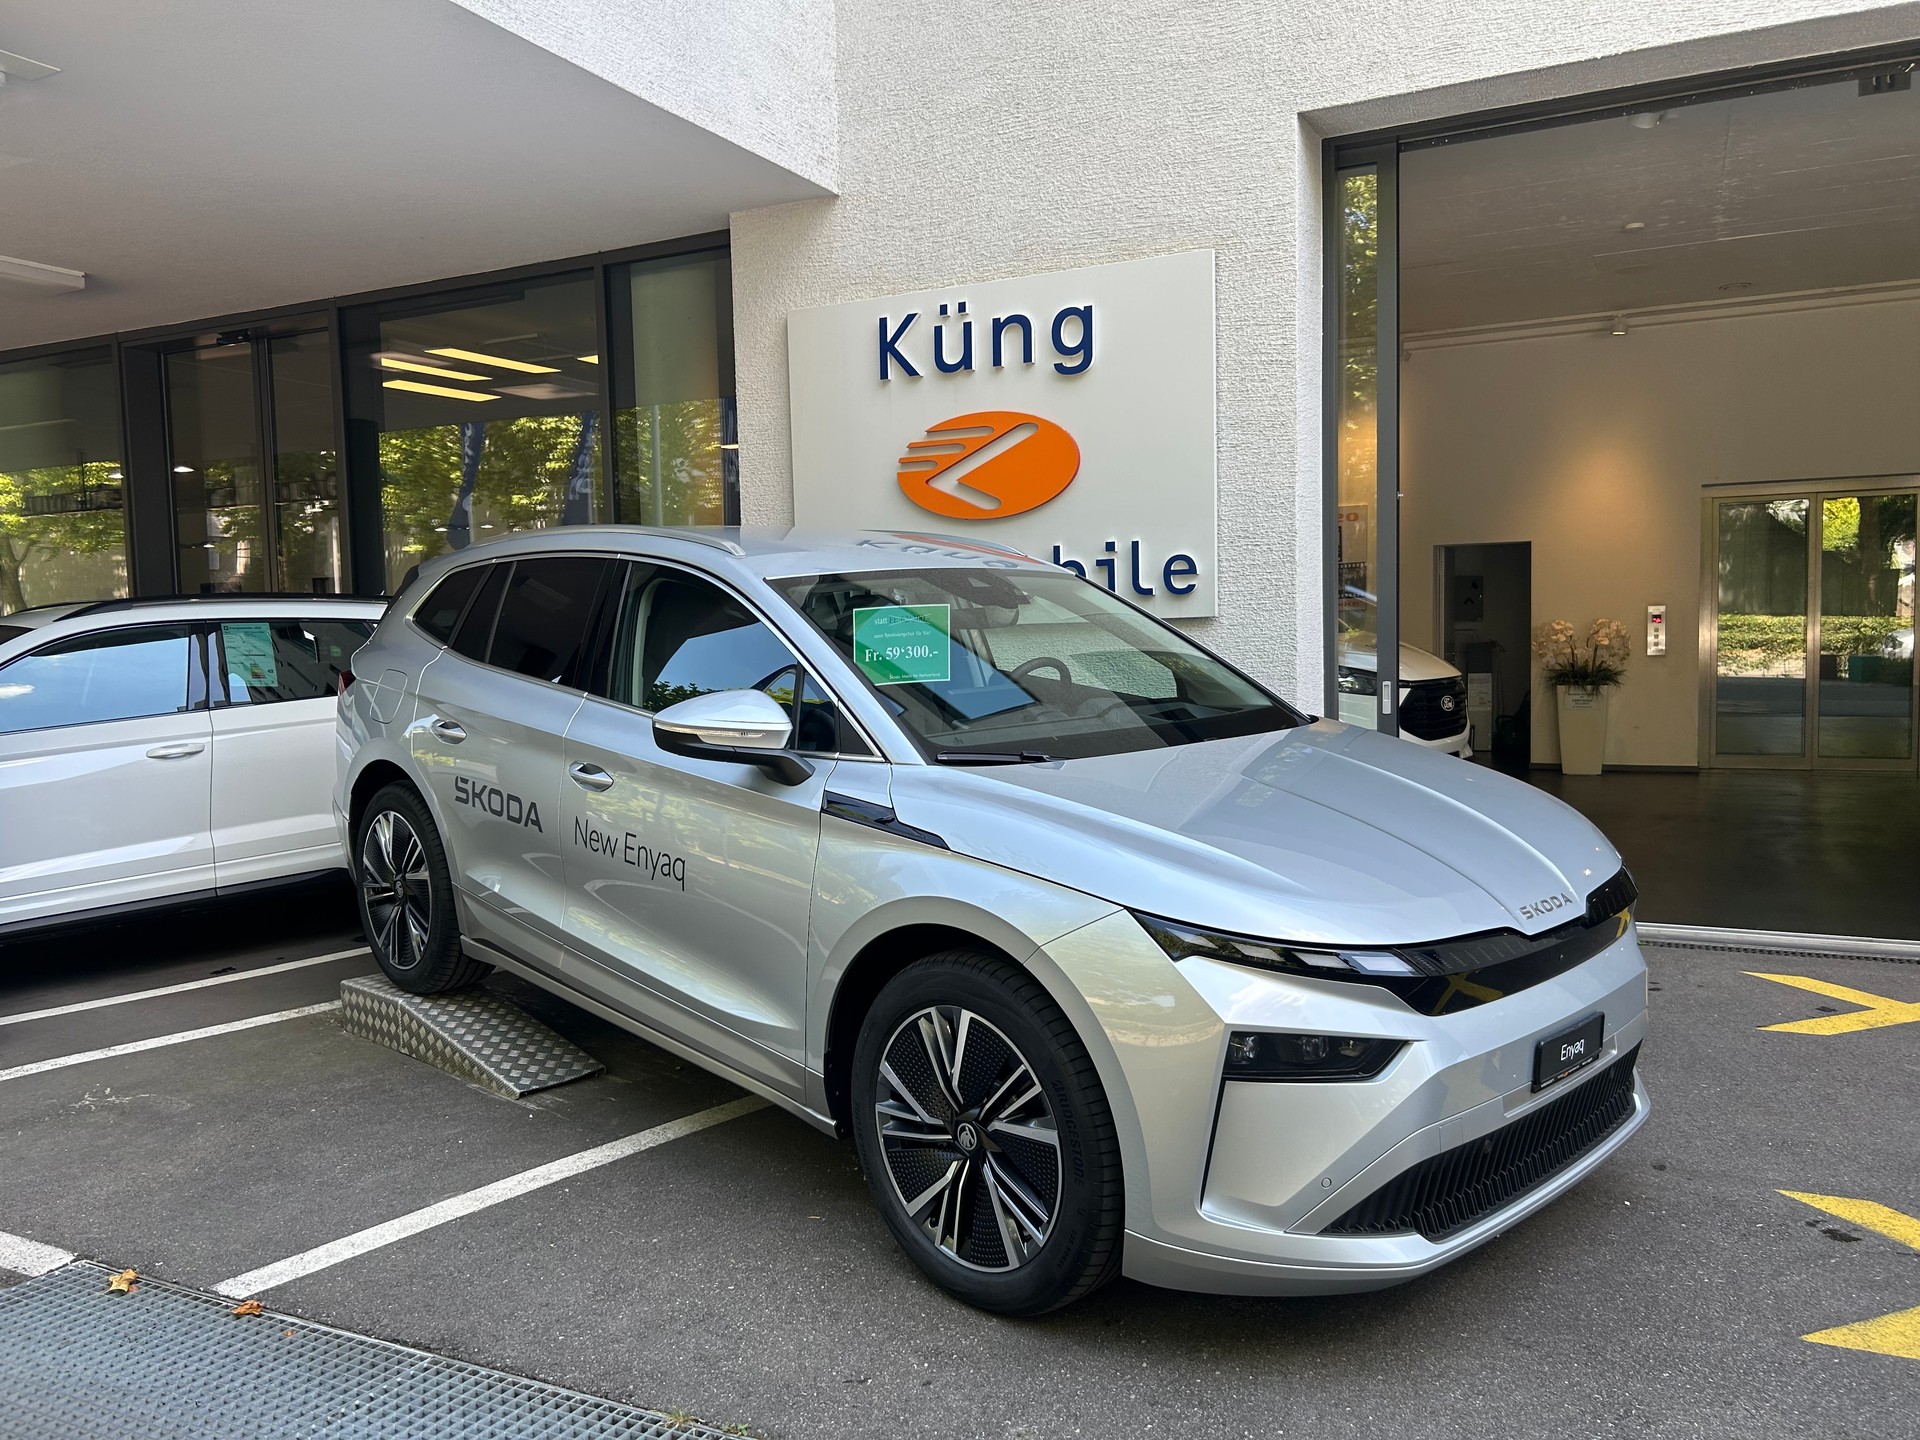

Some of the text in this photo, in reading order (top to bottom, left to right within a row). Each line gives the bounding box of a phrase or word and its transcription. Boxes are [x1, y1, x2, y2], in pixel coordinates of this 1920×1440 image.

[878, 301, 1095, 381] Küng
[865, 648, 882, 662] Fr.
[574, 816, 686, 891] New Enyaq
[1560, 1038, 1585, 1061] Enyaq
